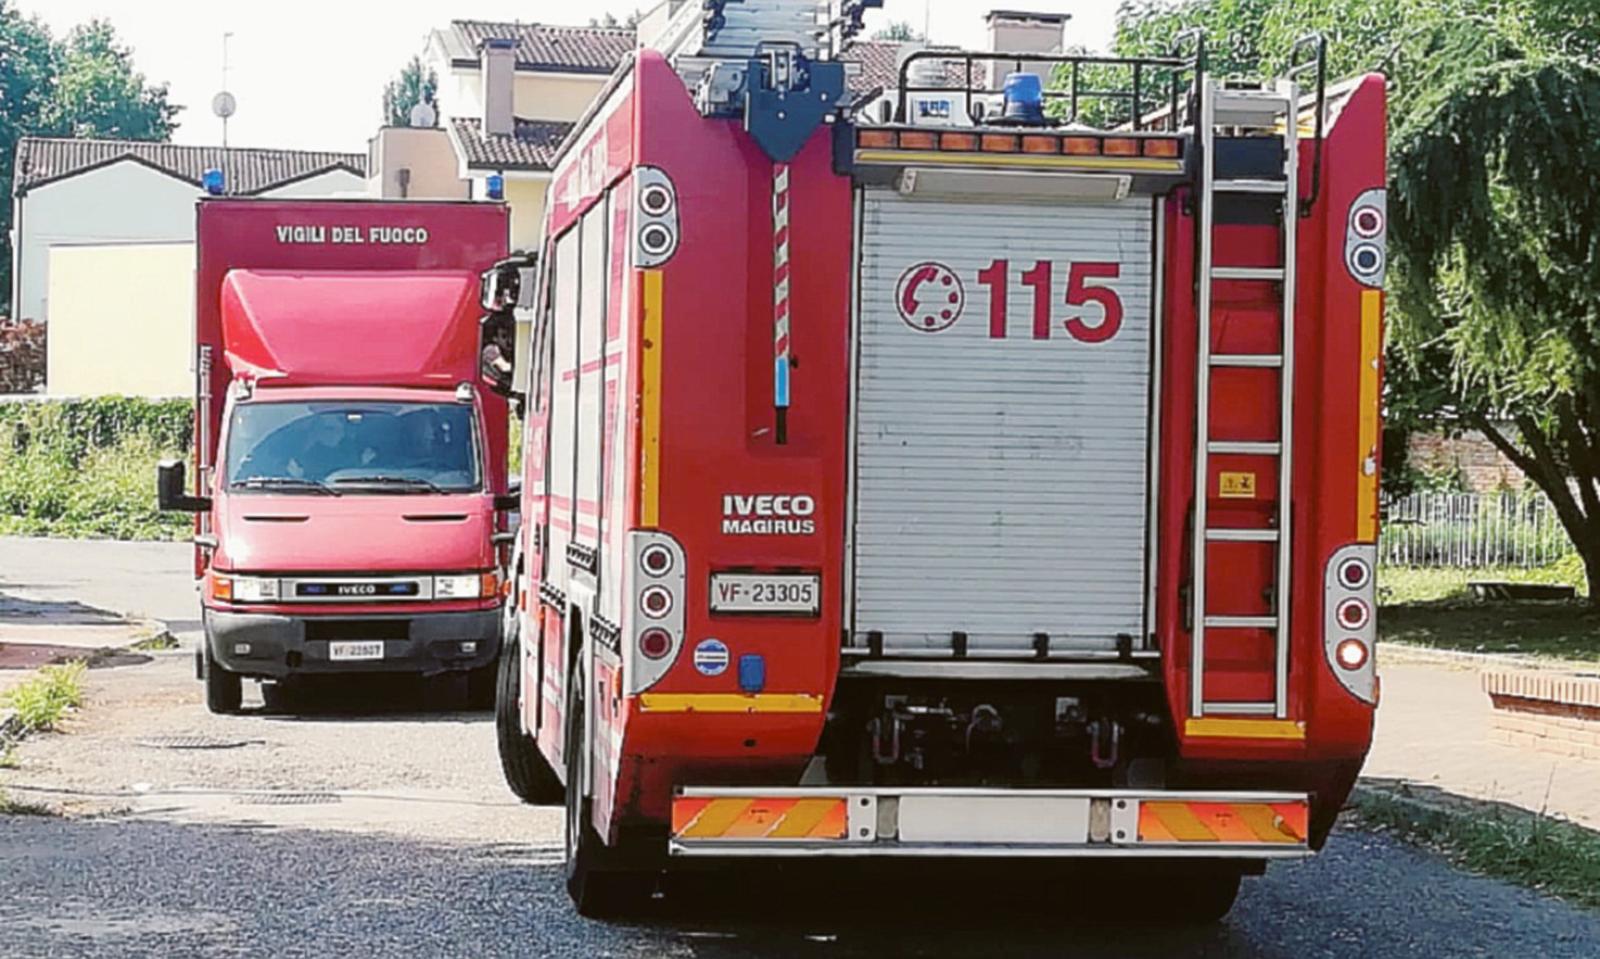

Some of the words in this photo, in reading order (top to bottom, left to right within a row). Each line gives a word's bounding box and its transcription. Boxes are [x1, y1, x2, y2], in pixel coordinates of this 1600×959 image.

[276, 225, 326, 243] VIGILI
[331, 226, 364, 243] DEL
[369, 227, 428, 244] FUOCO
[977, 258, 1124, 344] 115
[722, 494, 816, 516] IVECO
[722, 519, 816, 534] MAGIRUS
[338, 584, 376, 595] IVECO
